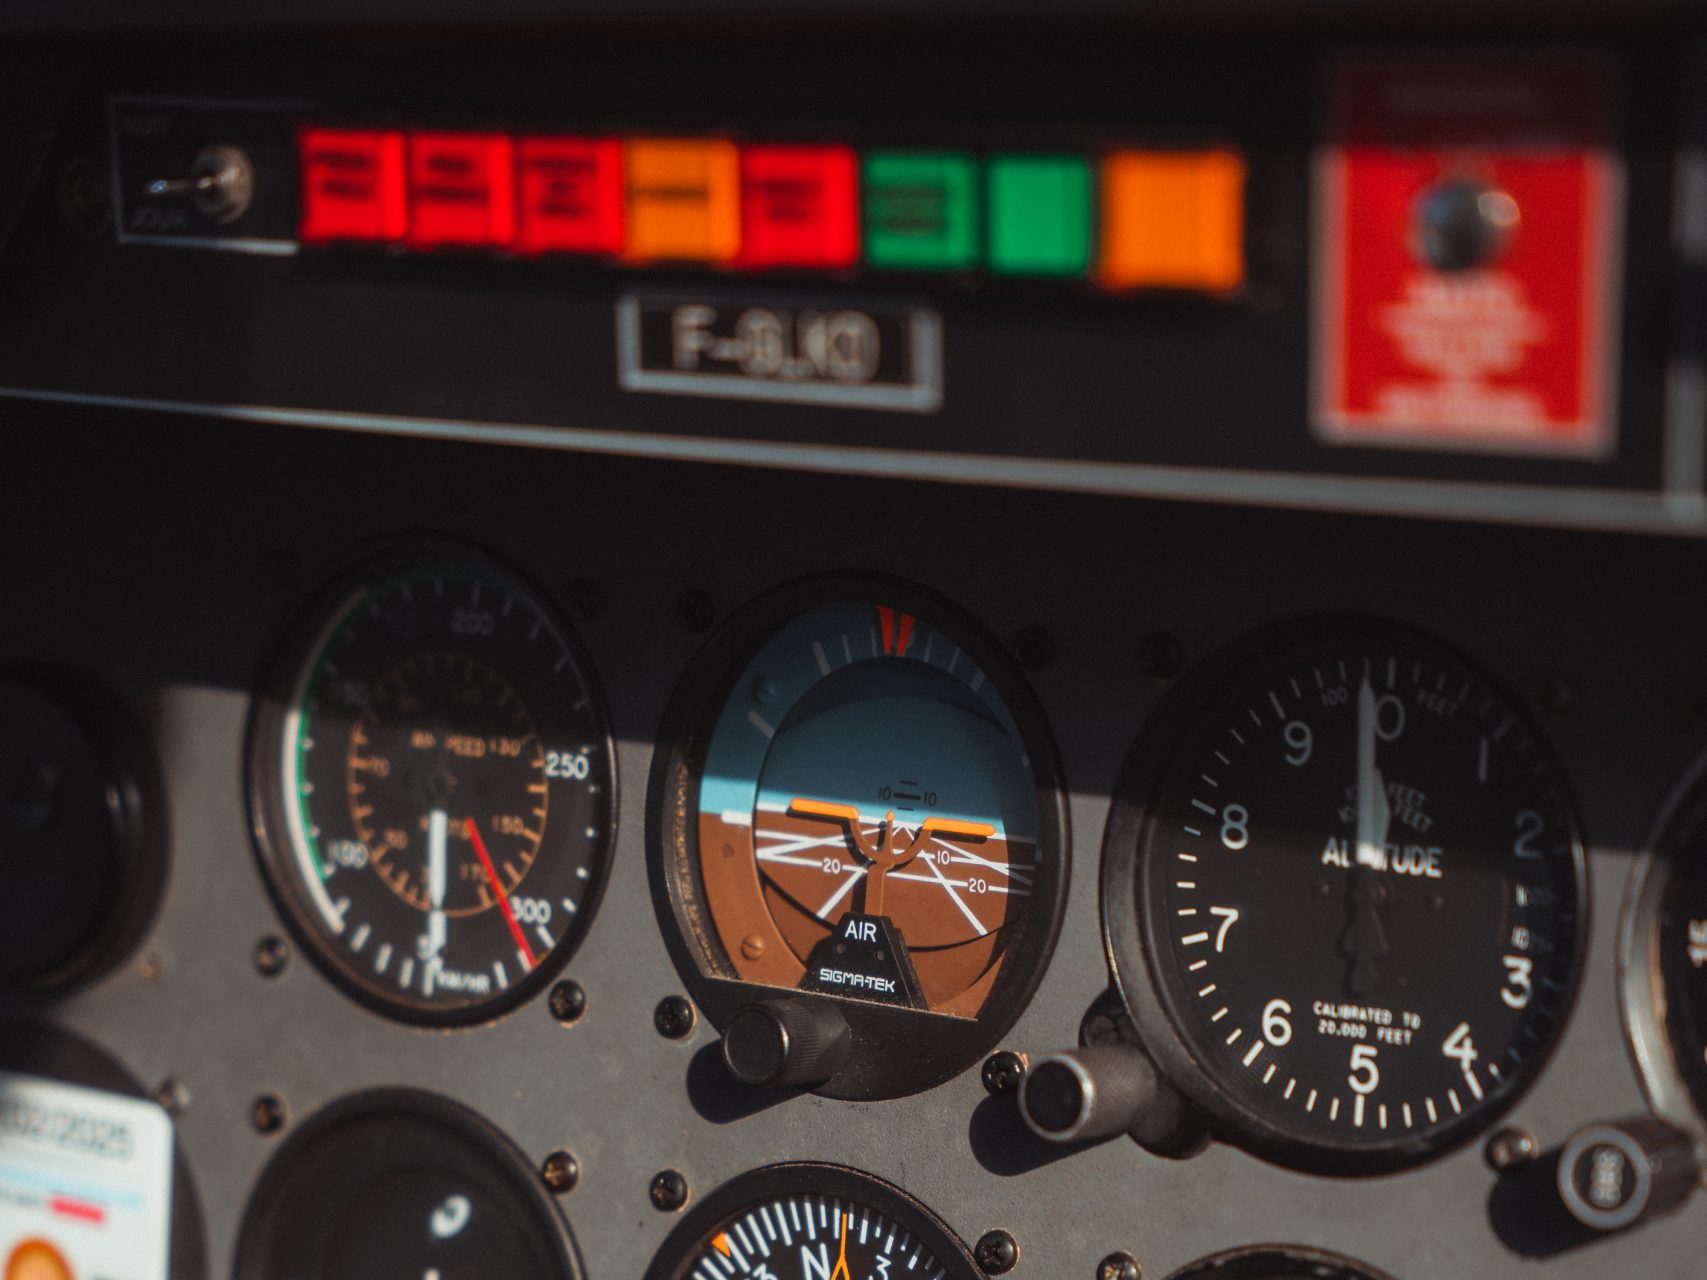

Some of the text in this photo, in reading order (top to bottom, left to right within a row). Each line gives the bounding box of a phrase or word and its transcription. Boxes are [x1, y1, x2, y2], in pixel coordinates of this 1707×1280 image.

[1375, 693, 1405, 741] 0
[544, 751, 589, 780] 250
[1283, 719, 1314, 766] 9
[1477, 736, 1490, 782] 1
[878, 787, 938, 806] 10 10
[1220, 804, 1249, 850] 8
[1513, 809, 1545, 859] 2
[822, 857, 841, 875] 20
[936, 850, 950, 866] 10
[968, 877, 987, 896] 20
[844, 919, 878, 943] AIR
[1209, 906, 1240, 953] 7
[1500, 954, 1535, 1009] 3
[1261, 998, 1293, 1047] 6
[1313, 999, 1422, 1031] CALIBRATED TO
[1376, 1025, 1413, 1046] FEET
[1442, 1022, 1479, 1070] 4
[1348, 1044, 1380, 1095] 5
